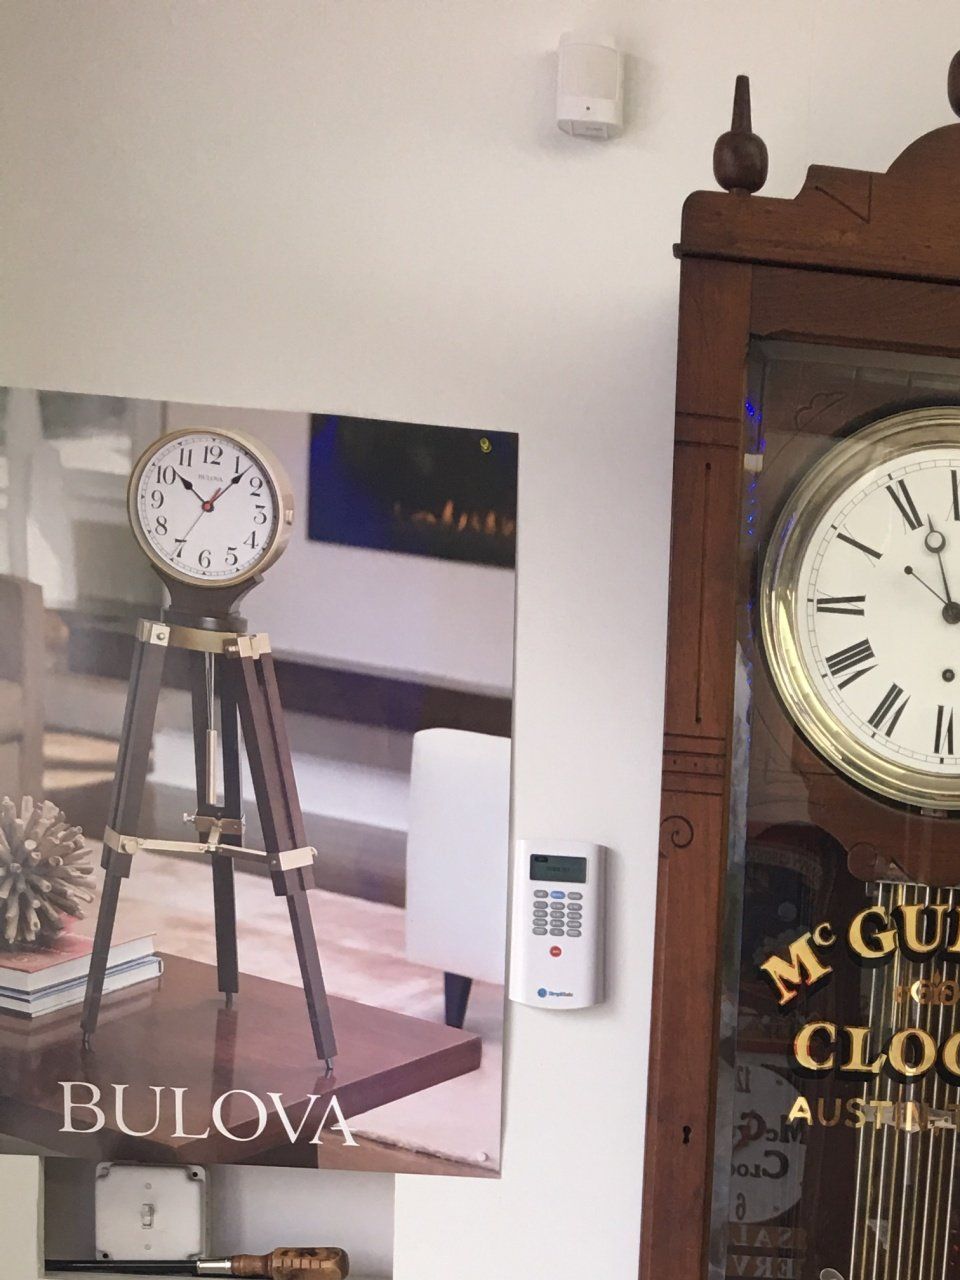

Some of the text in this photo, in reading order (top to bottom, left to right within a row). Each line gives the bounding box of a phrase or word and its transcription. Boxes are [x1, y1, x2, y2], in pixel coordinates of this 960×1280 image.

[179, 448, 193, 467] 11
[202, 444, 224, 466] 12
[234, 455, 240, 474] 1
[156, 465, 177, 485] 10
[250, 477, 263, 497] 2
[151, 490, 164, 509] 9
[253, 505, 267, 525] 3
[155, 515, 168, 536] 8
[174, 538, 187, 558] 7
[243, 530, 259, 549] 4
[198, 549, 211, 569] 6
[225, 546, 238, 566] 5
[57, 1081, 361, 1147] BULOVA
